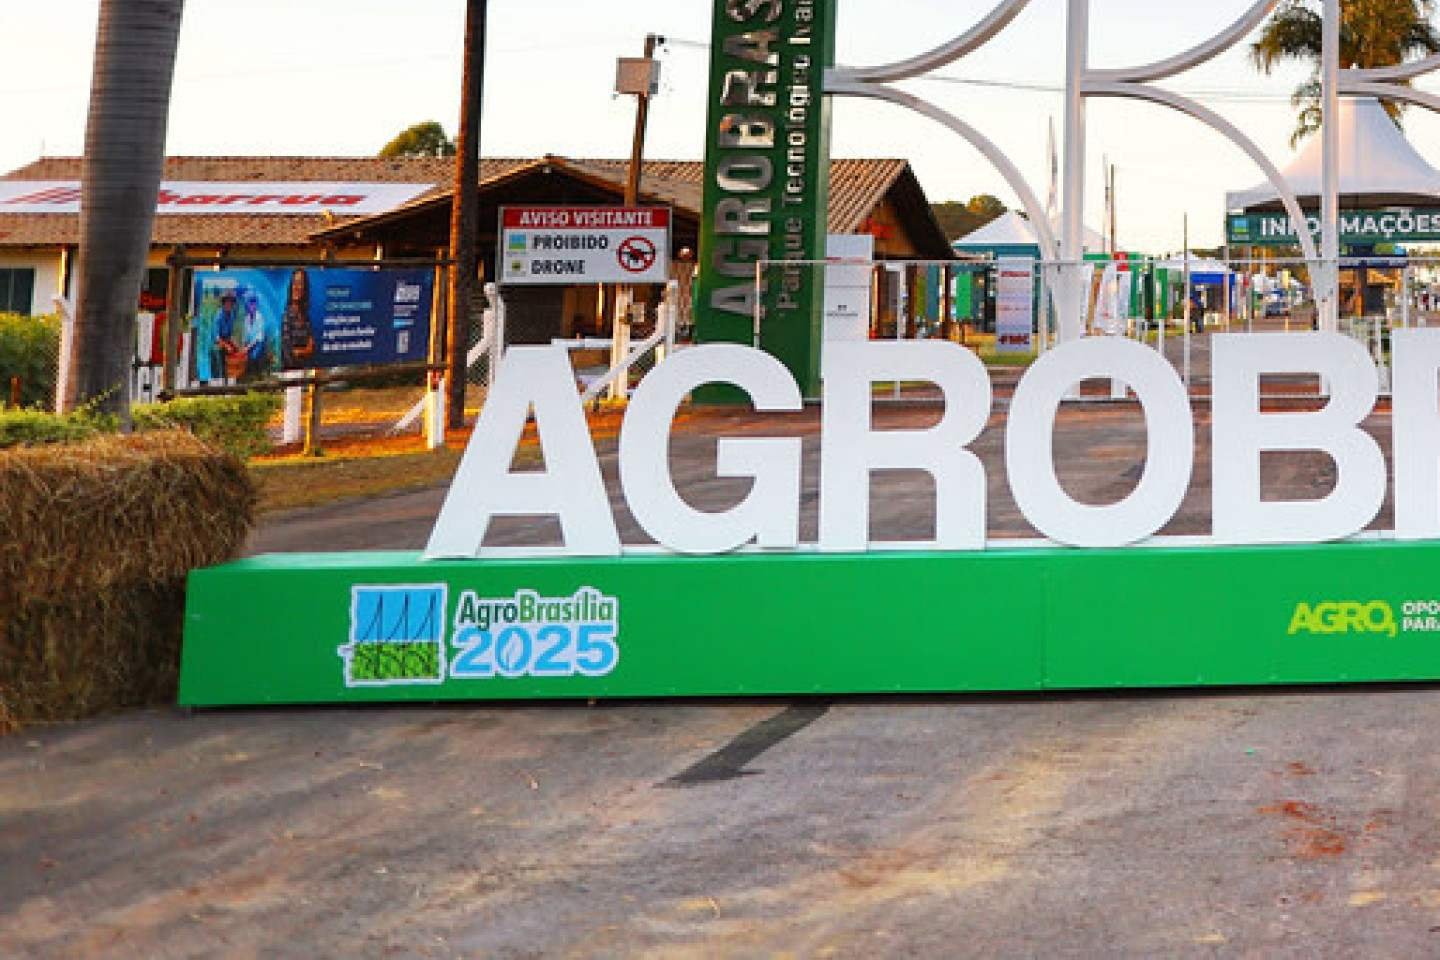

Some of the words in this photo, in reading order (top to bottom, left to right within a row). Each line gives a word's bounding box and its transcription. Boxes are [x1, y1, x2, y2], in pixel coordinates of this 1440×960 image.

[519, 211, 570, 226] AVISO
[573, 211, 653, 226] VISITANTE
[533, 234, 609, 250] PROIBIDO
[531, 259, 586, 275] DRONE
[458, 591, 614, 631] AgroBrasília
[453, 624, 614, 673] 2025
